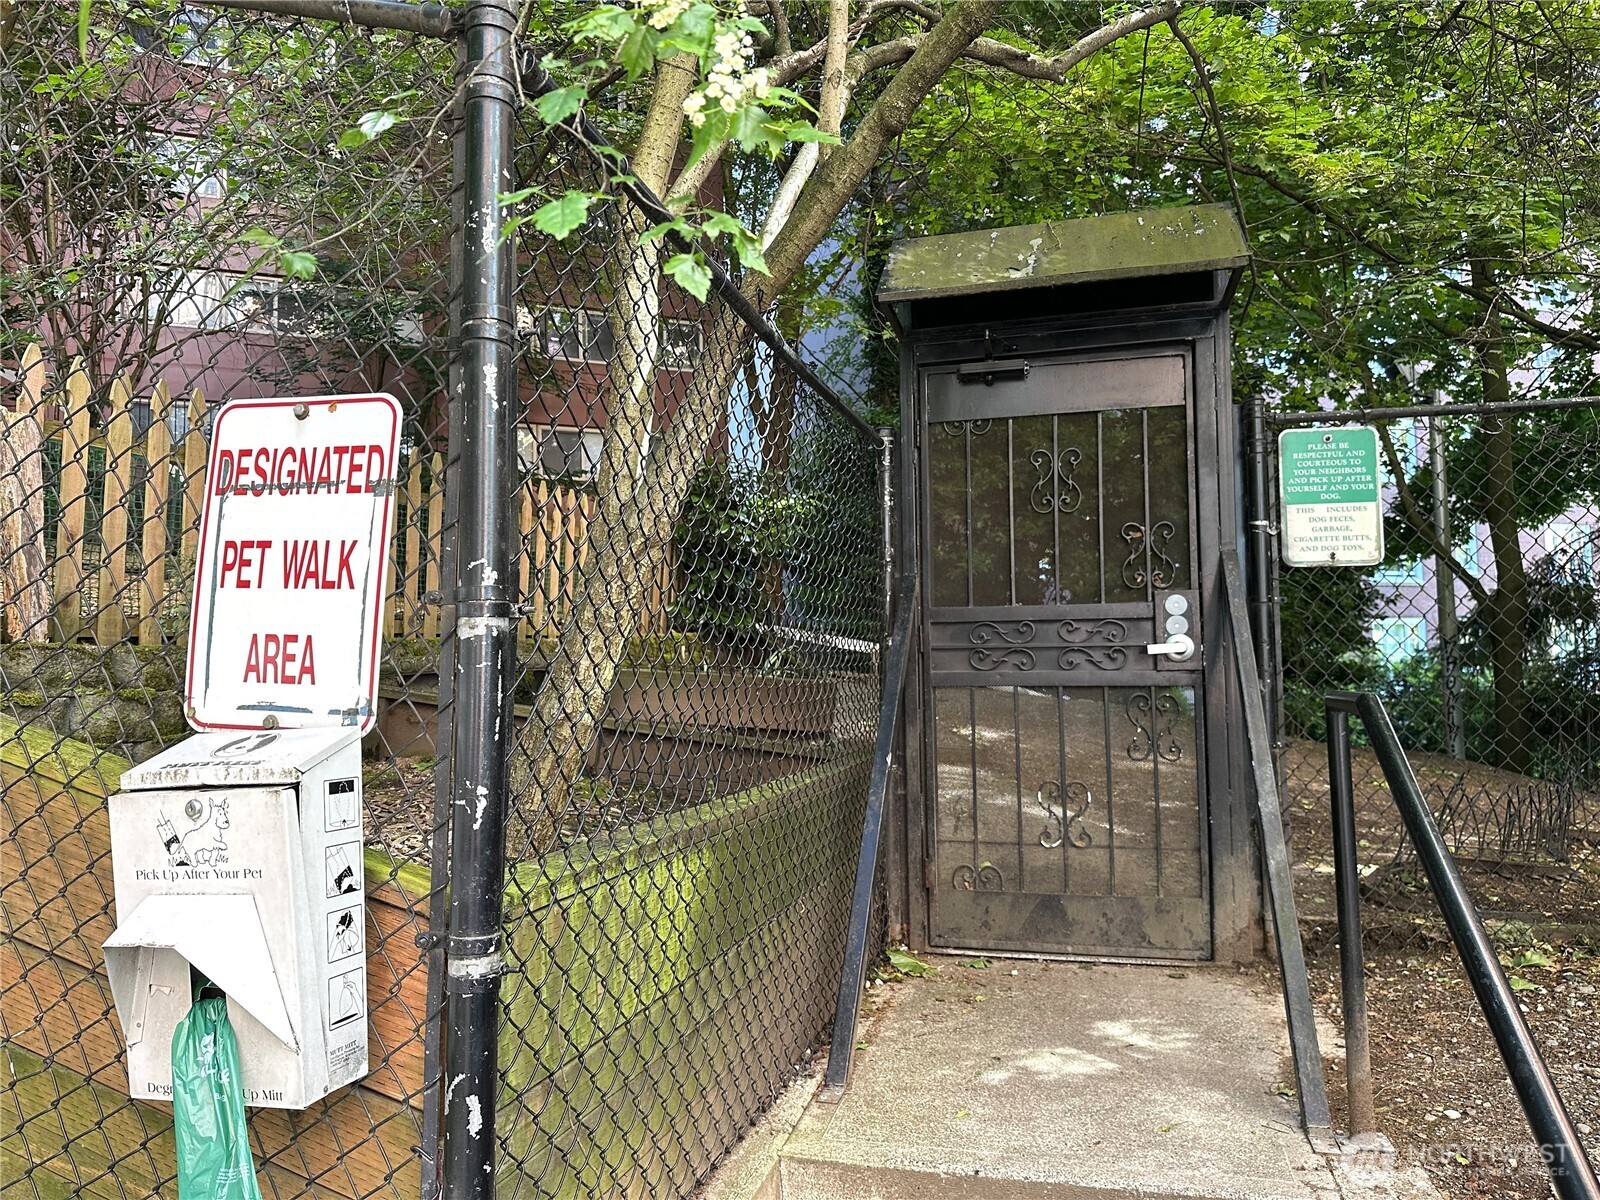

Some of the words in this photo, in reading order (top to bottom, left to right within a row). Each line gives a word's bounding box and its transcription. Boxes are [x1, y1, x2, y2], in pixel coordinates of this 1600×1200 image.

[214, 445, 384, 496] DESIGNATED
[1293, 451, 1343, 459] RESPECTFUL
[220, 540, 272, 589] PET
[283, 539, 358, 590] WALK
[243, 633, 316, 685] AREA
[135, 868, 160, 881] Pick
[163, 869, 179, 882] Up
[181, 868, 210, 880] After
[214, 868, 241, 880] Your
[243, 868, 263, 879] Pet
[242, 1089, 259, 1102] Up
[262, 1089, 283, 1101] Mitt
